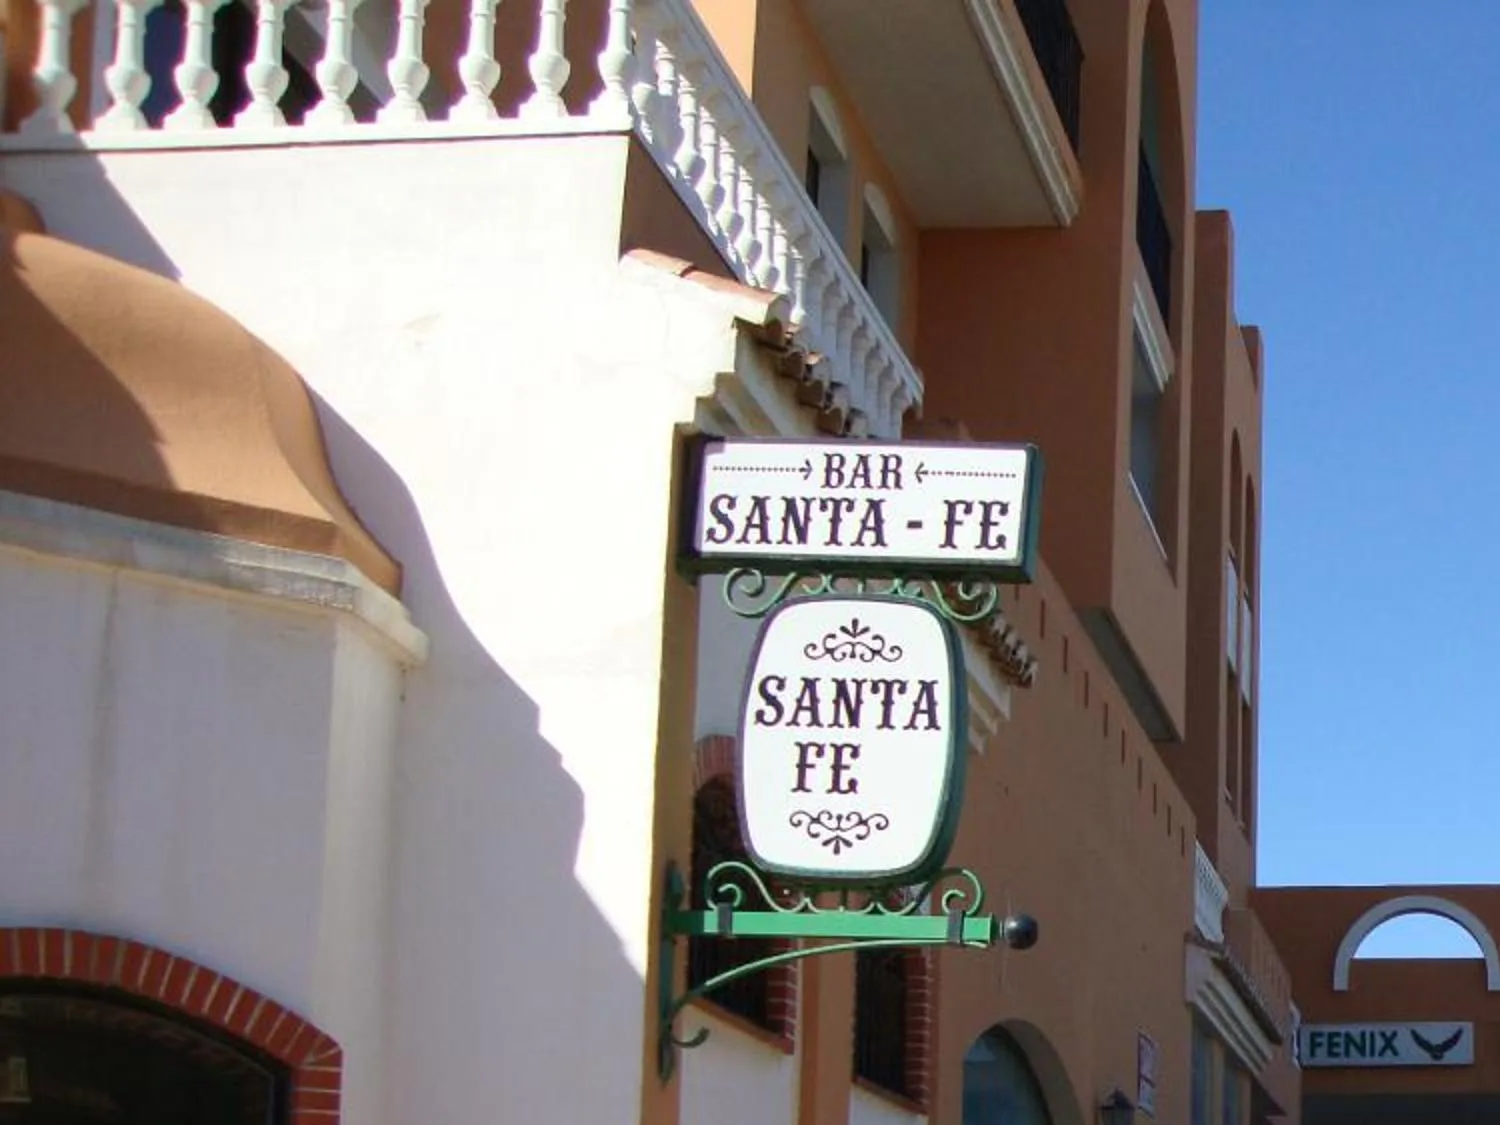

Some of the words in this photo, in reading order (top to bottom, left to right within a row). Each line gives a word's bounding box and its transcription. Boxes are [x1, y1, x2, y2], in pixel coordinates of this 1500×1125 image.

[820, 453, 904, 490] BAR
[706, 493, 888, 547] SANTA
[938, 499, 1011, 550] FE
[753, 674, 942, 732] SANTA
[790, 741, 862, 795] FE
[1308, 1030, 1400, 1058] FENIX
